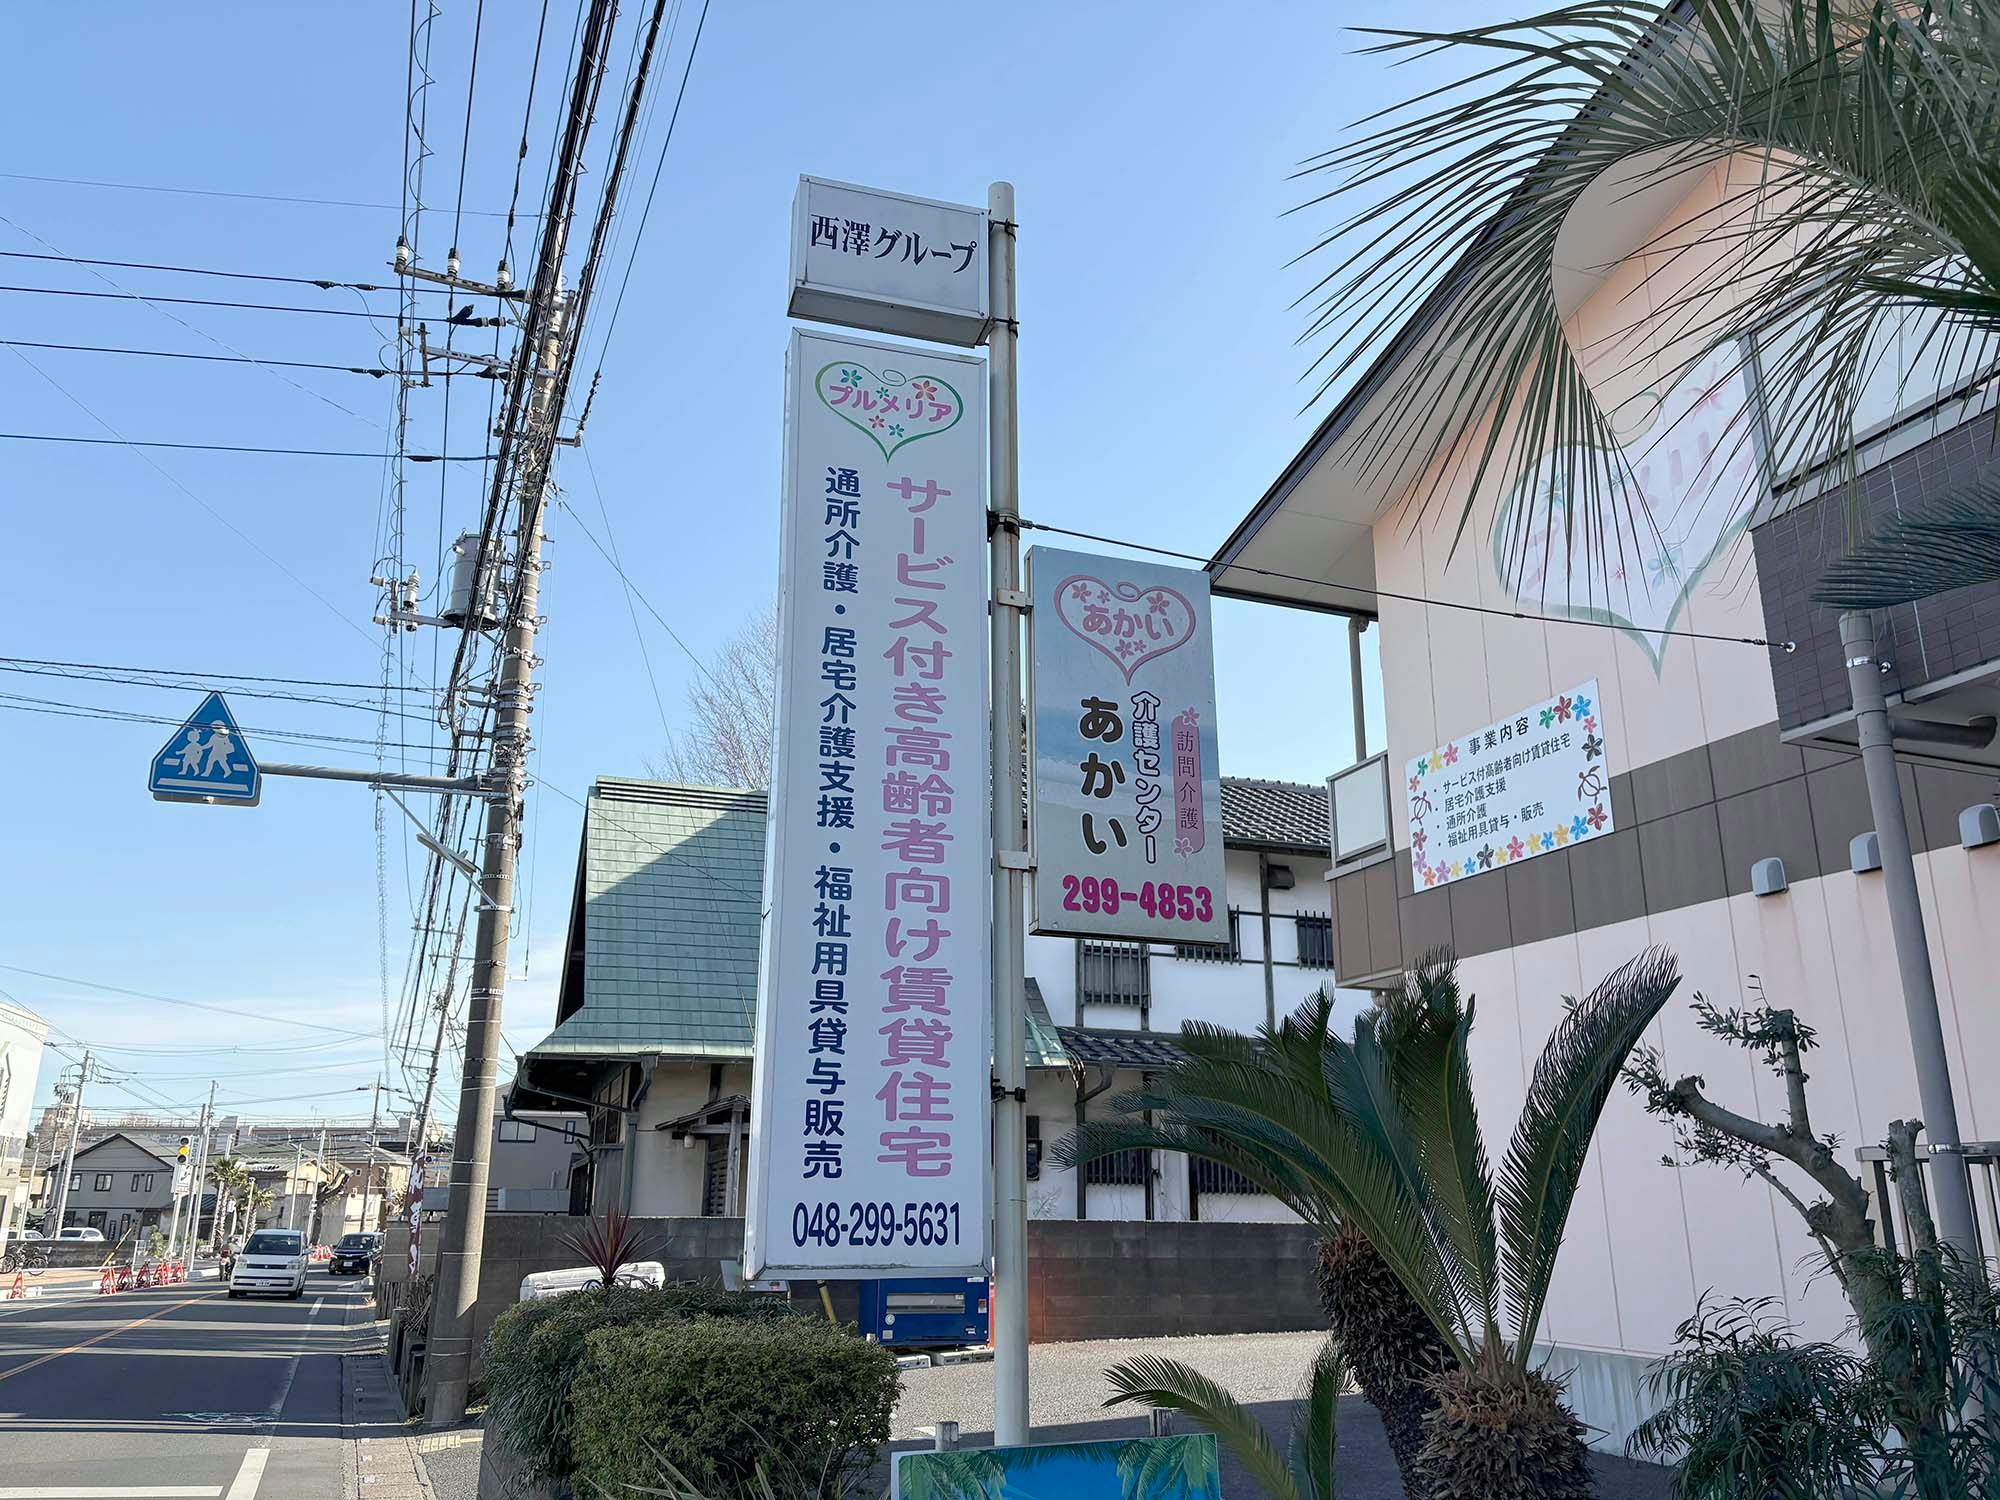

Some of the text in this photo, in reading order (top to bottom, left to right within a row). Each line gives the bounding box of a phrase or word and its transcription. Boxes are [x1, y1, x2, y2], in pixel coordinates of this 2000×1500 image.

[810, 213, 978, 274] 西澤グループ
[829, 384, 952, 423] プルメリア
[1082, 603, 1174, 640] あかい
[1467, 716, 1530, 756] 事業内容
[1079, 695, 1128, 856] あかい
[1130, 690, 1162, 864] 介護センター
[1175, 730, 1199, 831] 訪問介護
[874, 476, 954, 1177] サービス付き高齢者向け賃貸住宅
[1062, 874, 1214, 922] 299-4853
[793, 1201, 960, 1247] 048-299-5631
